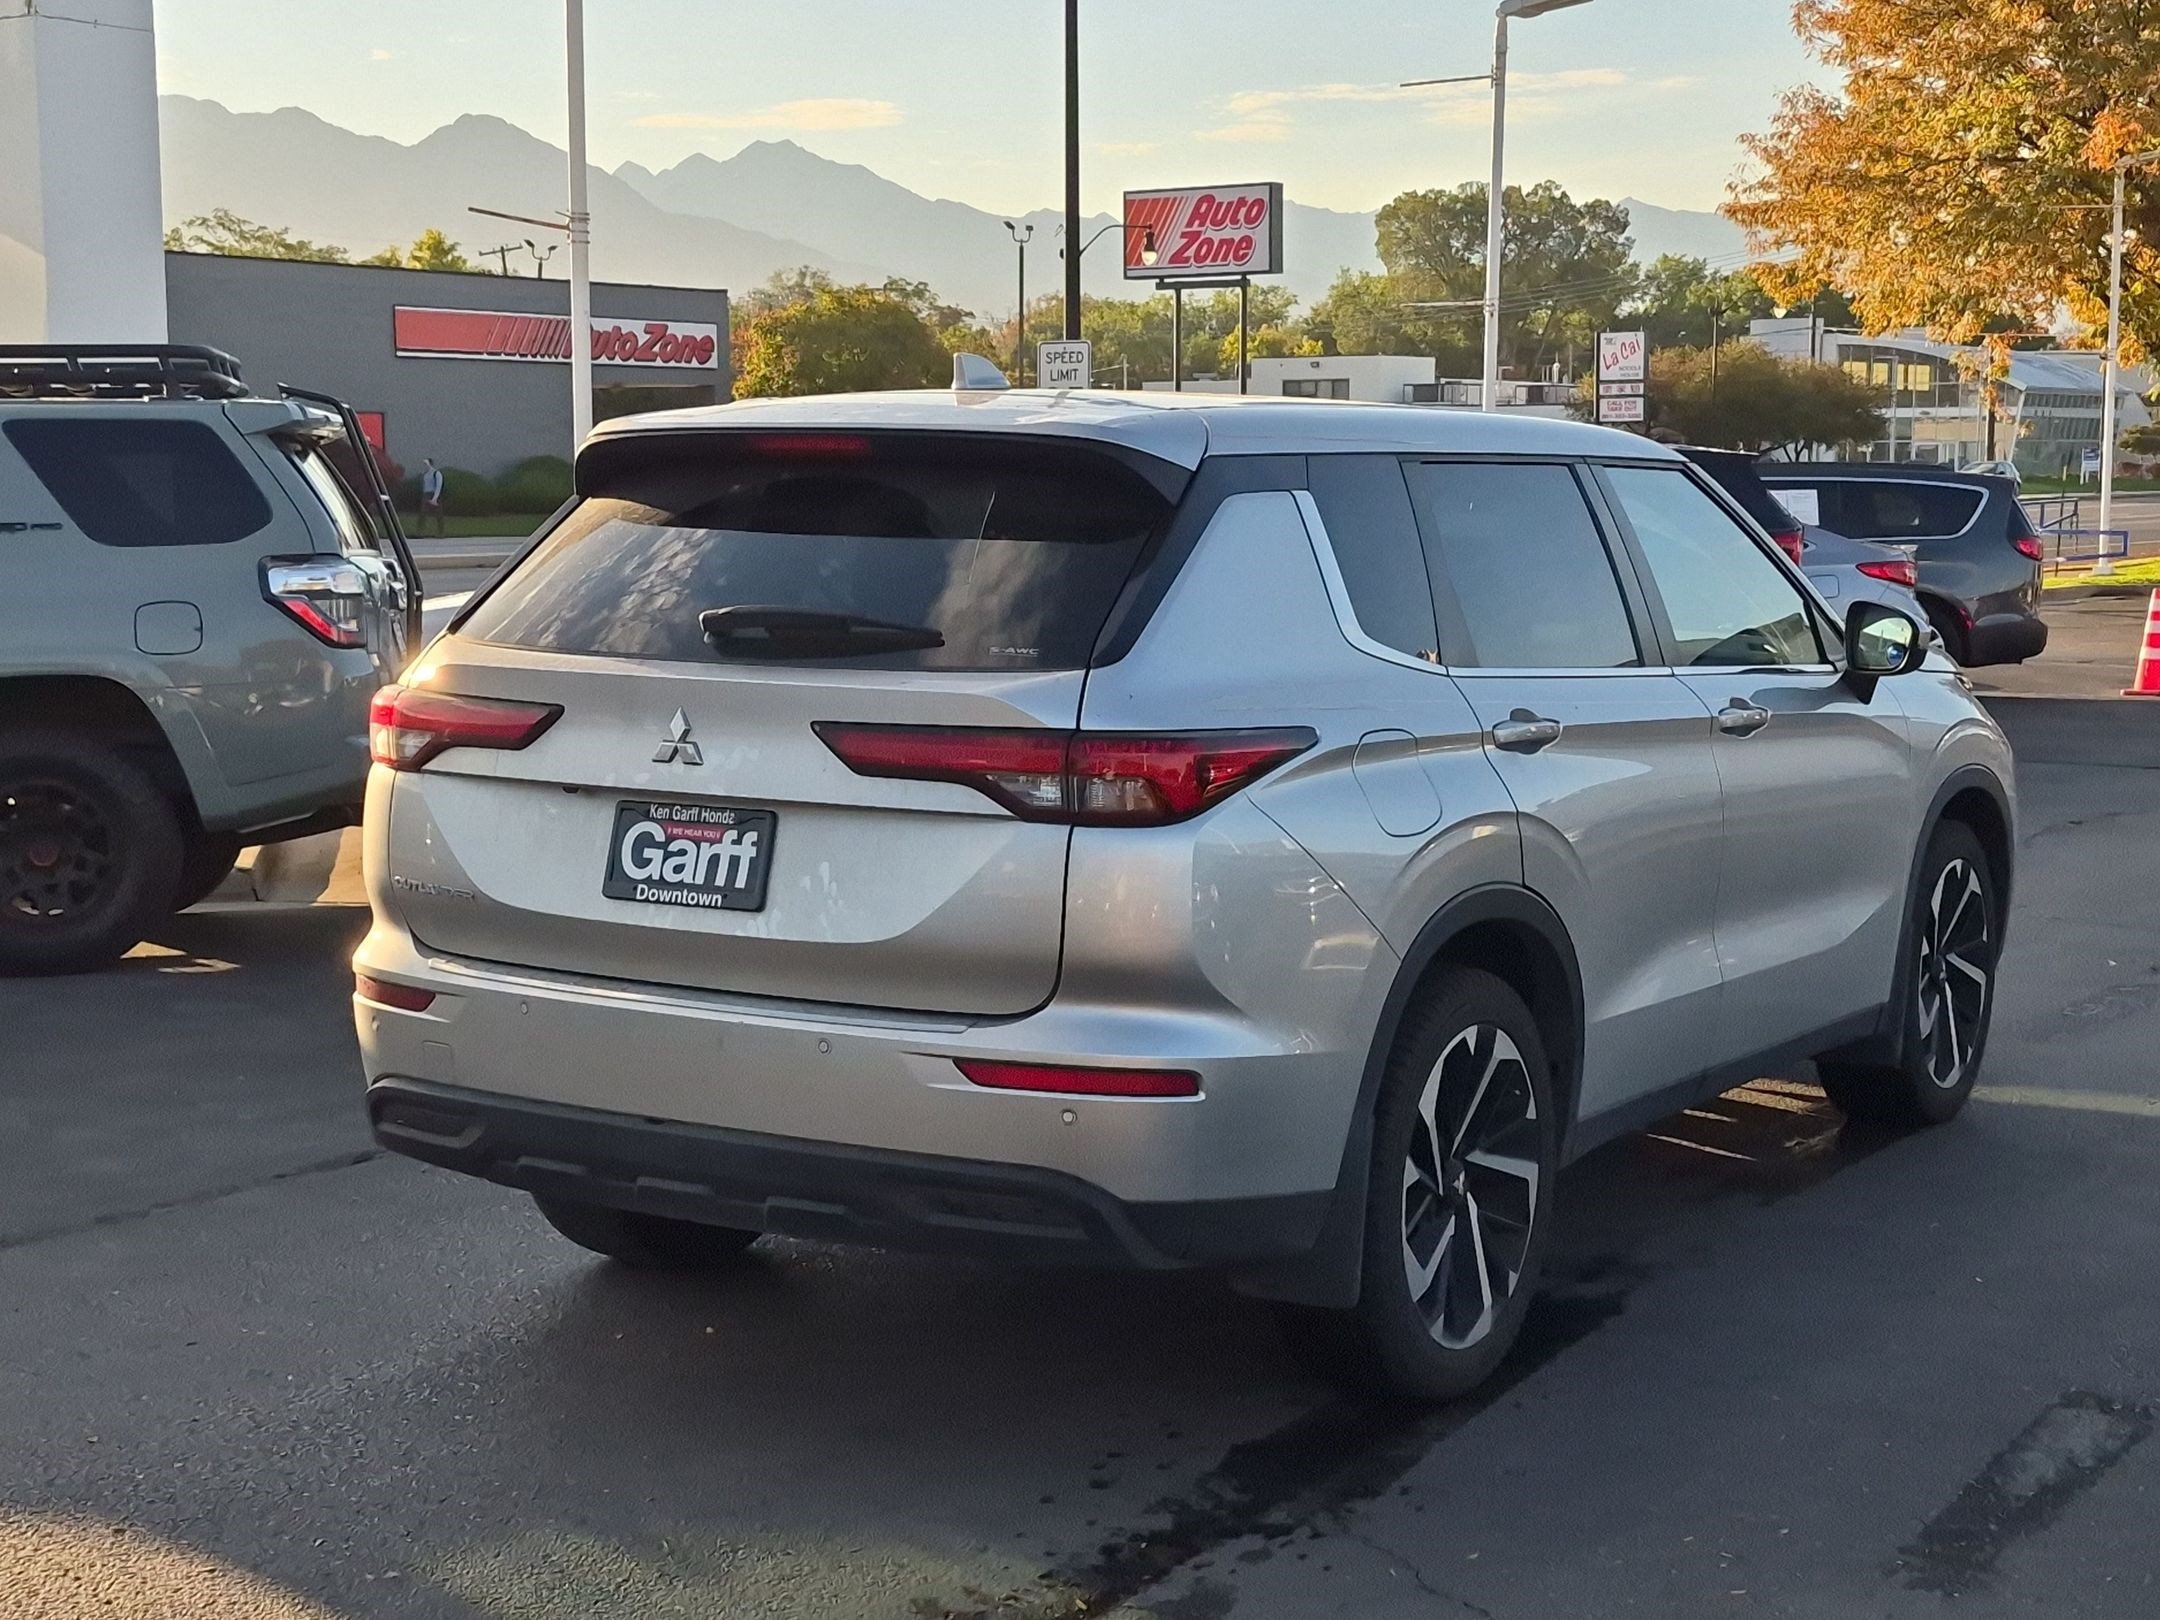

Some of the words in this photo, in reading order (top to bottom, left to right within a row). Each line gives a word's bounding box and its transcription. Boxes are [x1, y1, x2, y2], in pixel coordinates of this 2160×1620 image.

[1185, 193, 1268, 229] Auto
[1168, 231, 1254, 266] Zone
[1045, 351, 1084, 364] SPEED
[1602, 352, 1620, 370] La
[1620, 333, 1641, 360] Cai
[1050, 369, 1079, 382] LIMIT
[650, 804, 669, 819] Ken
[672, 805, 699, 822] Garff
[701, 808, 736, 824] Honda
[621, 820, 758, 889] Garff
[636, 883, 723, 907] Downtown
